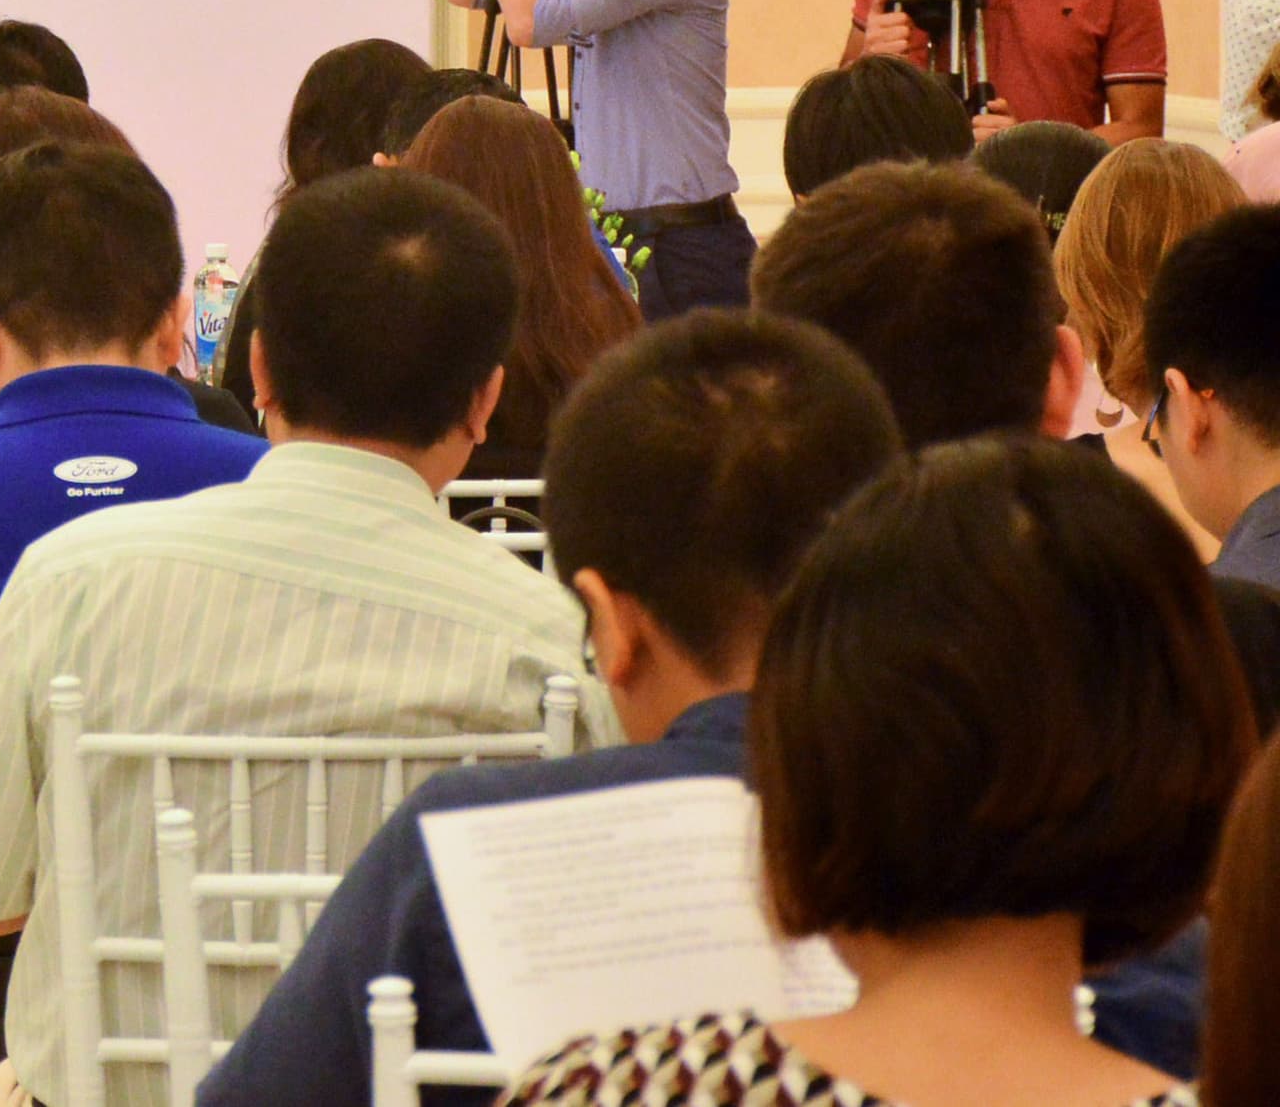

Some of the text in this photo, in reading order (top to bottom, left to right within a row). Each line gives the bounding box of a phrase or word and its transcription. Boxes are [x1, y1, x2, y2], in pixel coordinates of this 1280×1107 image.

[199, 312, 228, 335] Vita
[66, 486, 124, 497] Go Further
